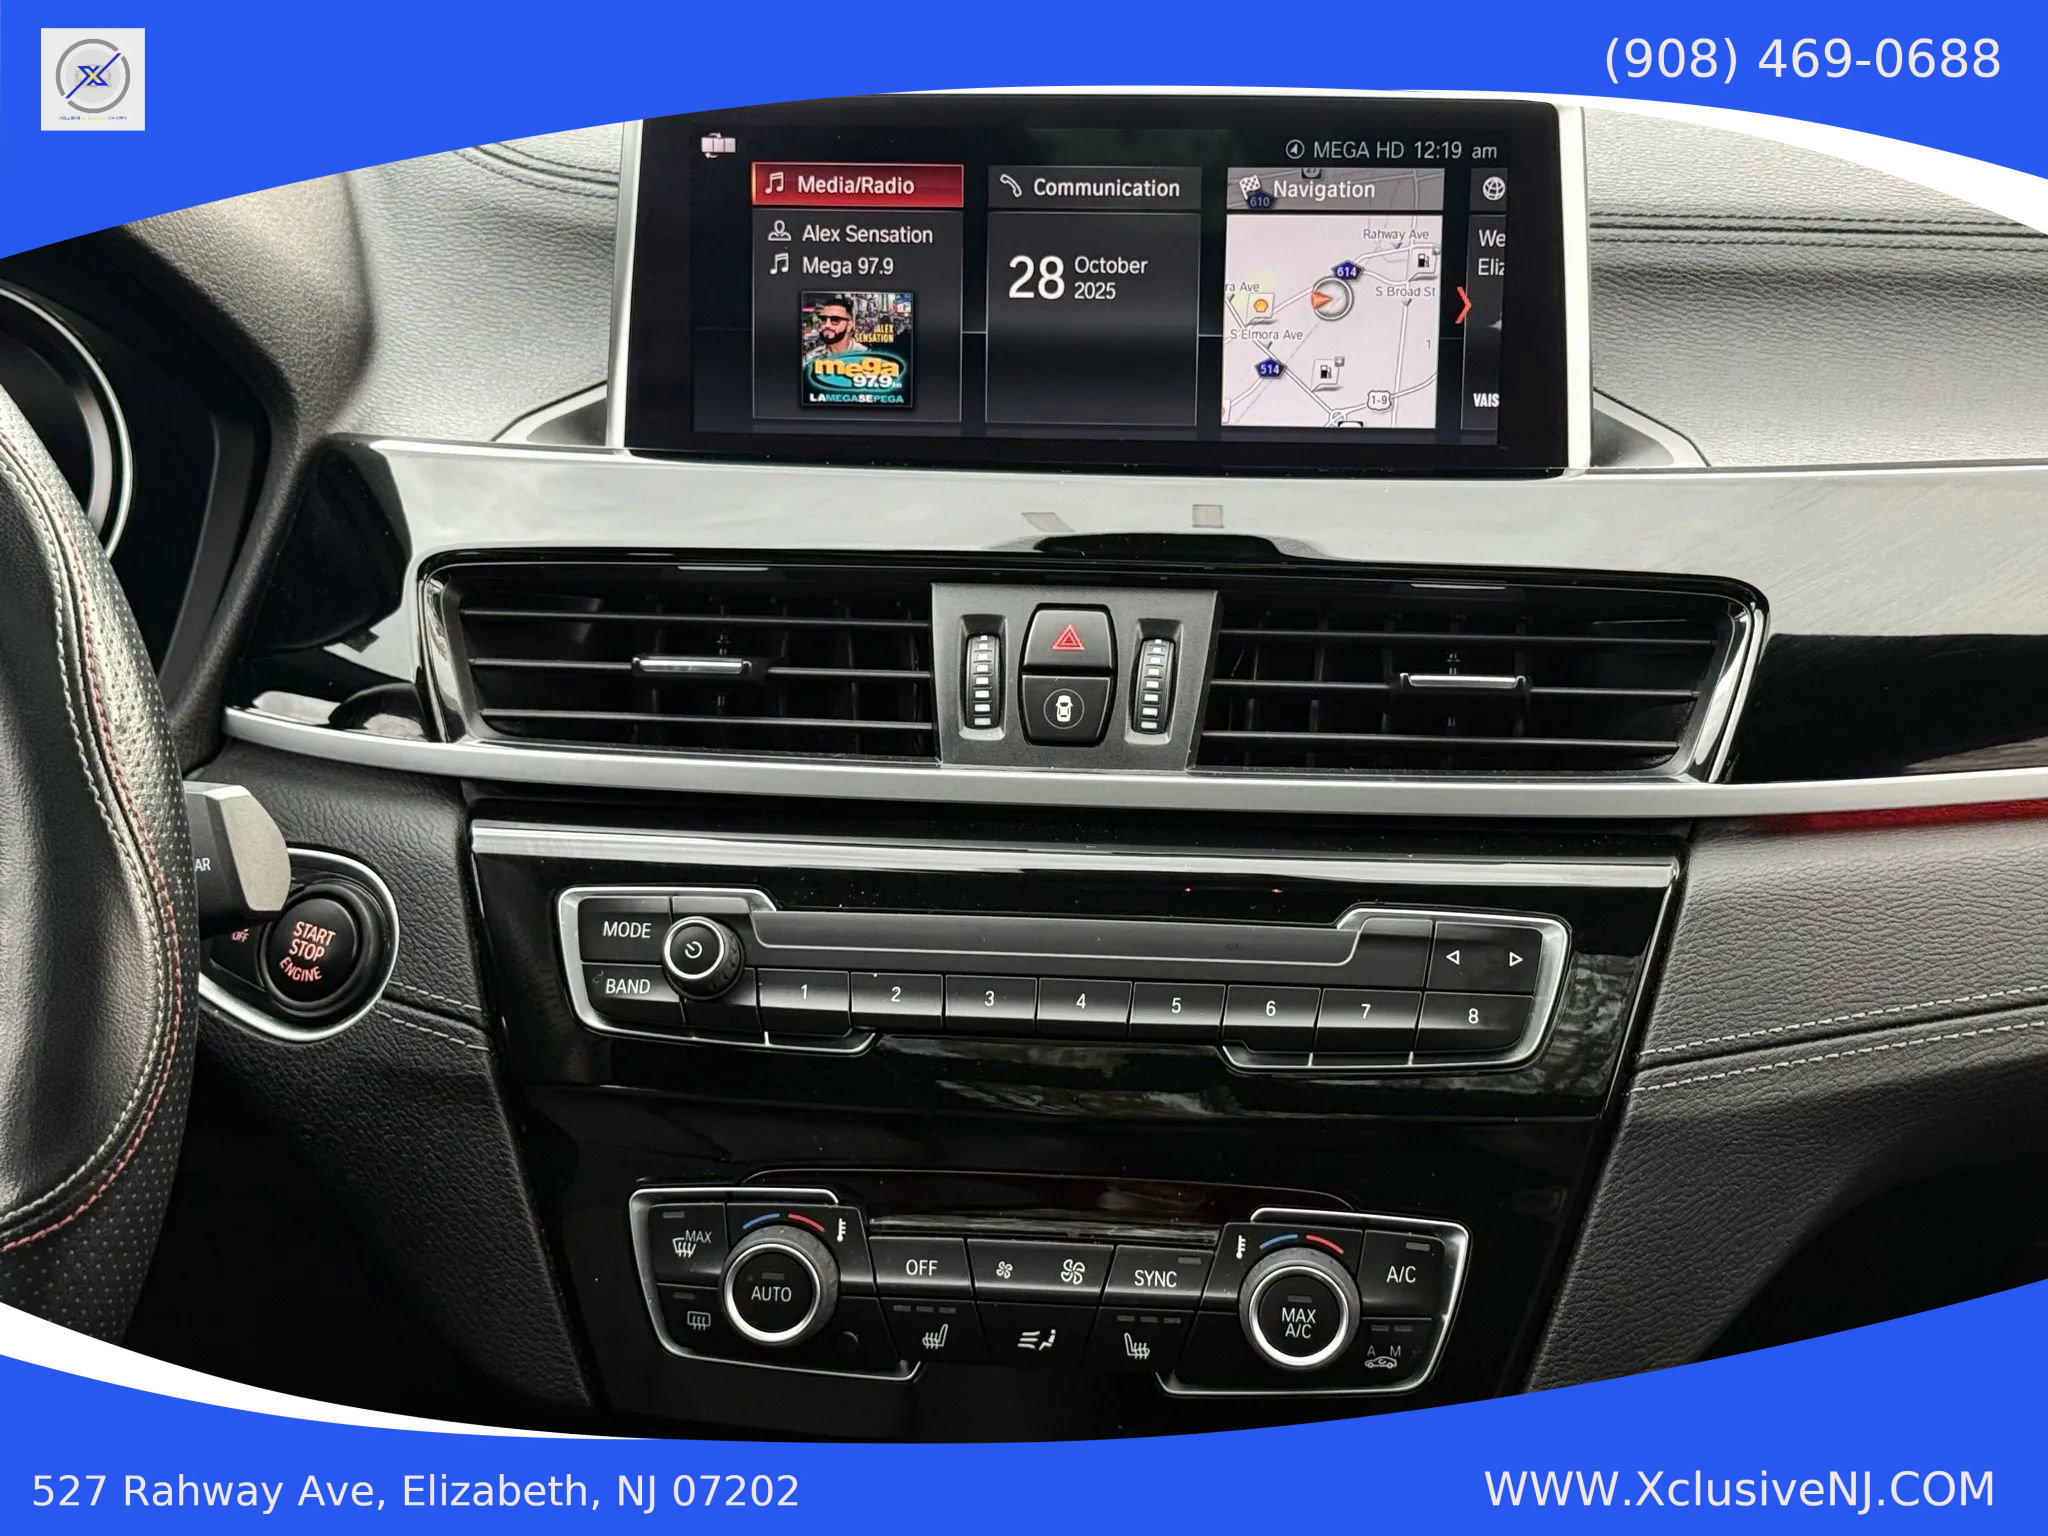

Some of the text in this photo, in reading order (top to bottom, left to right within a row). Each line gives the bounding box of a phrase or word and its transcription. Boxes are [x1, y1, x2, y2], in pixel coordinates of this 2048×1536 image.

[1313, 141, 1498, 160] MEGA HD 12:19 am
[797, 175, 915, 196] Media/Radio
[1033, 178, 1180, 198] Communication
[1273, 180, 1376, 202] Navigation
[1249, 196, 1271, 208] 610
[802, 225, 934, 244] Alex Sensation
[1362, 228, 1430, 242] Rahway Ave
[1478, 228, 1506, 248] We
[802, 256, 894, 277] Mega 97.9
[1074, 255, 1149, 275] October
[1336, 265, 1357, 278] 614
[1008, 255, 1065, 300] 28
[1074, 281, 1117, 300] 2025
[1239, 281, 1260, 292] Ave
[1375, 286, 1436, 297] S Broad St
[875, 324, 894, 333] ALEX
[1229, 328, 1304, 341] S Elmora Ave
[854, 333, 894, 343] SENSATION
[815, 357, 900, 377] mega
[1259, 363, 1280, 375] 514
[852, 374, 893, 388] 97.9
[1370, 394, 1388, 405] 1-9
[1473, 392, 1500, 408] VAIS
[194, 857, 212, 873] AR
[231, 931, 250, 943] OFF
[293, 921, 337, 946] START
[602, 921, 652, 939] MODE
[288, 938, 325, 962] STOP
[278, 956, 323, 982] ENGINE
[605, 978, 651, 995] BAND
[800, 984, 808, 1001] 1
[890, 985, 901, 1003] 2
[984, 990, 995, 1007] 3
[1076, 993, 1087, 1010] 4
[1170, 997, 1182, 1014] 5
[1265, 1000, 1277, 1017] 6
[1360, 1003, 1371, 1020] 7
[1467, 1008, 1479, 1025] 8
[684, 1230, 712, 1245] MAX
[905, 1259, 938, 1277] OFF
[1386, 1265, 1417, 1284] A/C
[1134, 1269, 1178, 1288] SYNC
[751, 1285, 792, 1302] AUTO
[1281, 1306, 1317, 1324] MAX
[1285, 1323, 1312, 1339] A/C
[1367, 1345, 1401, 1357] A M
